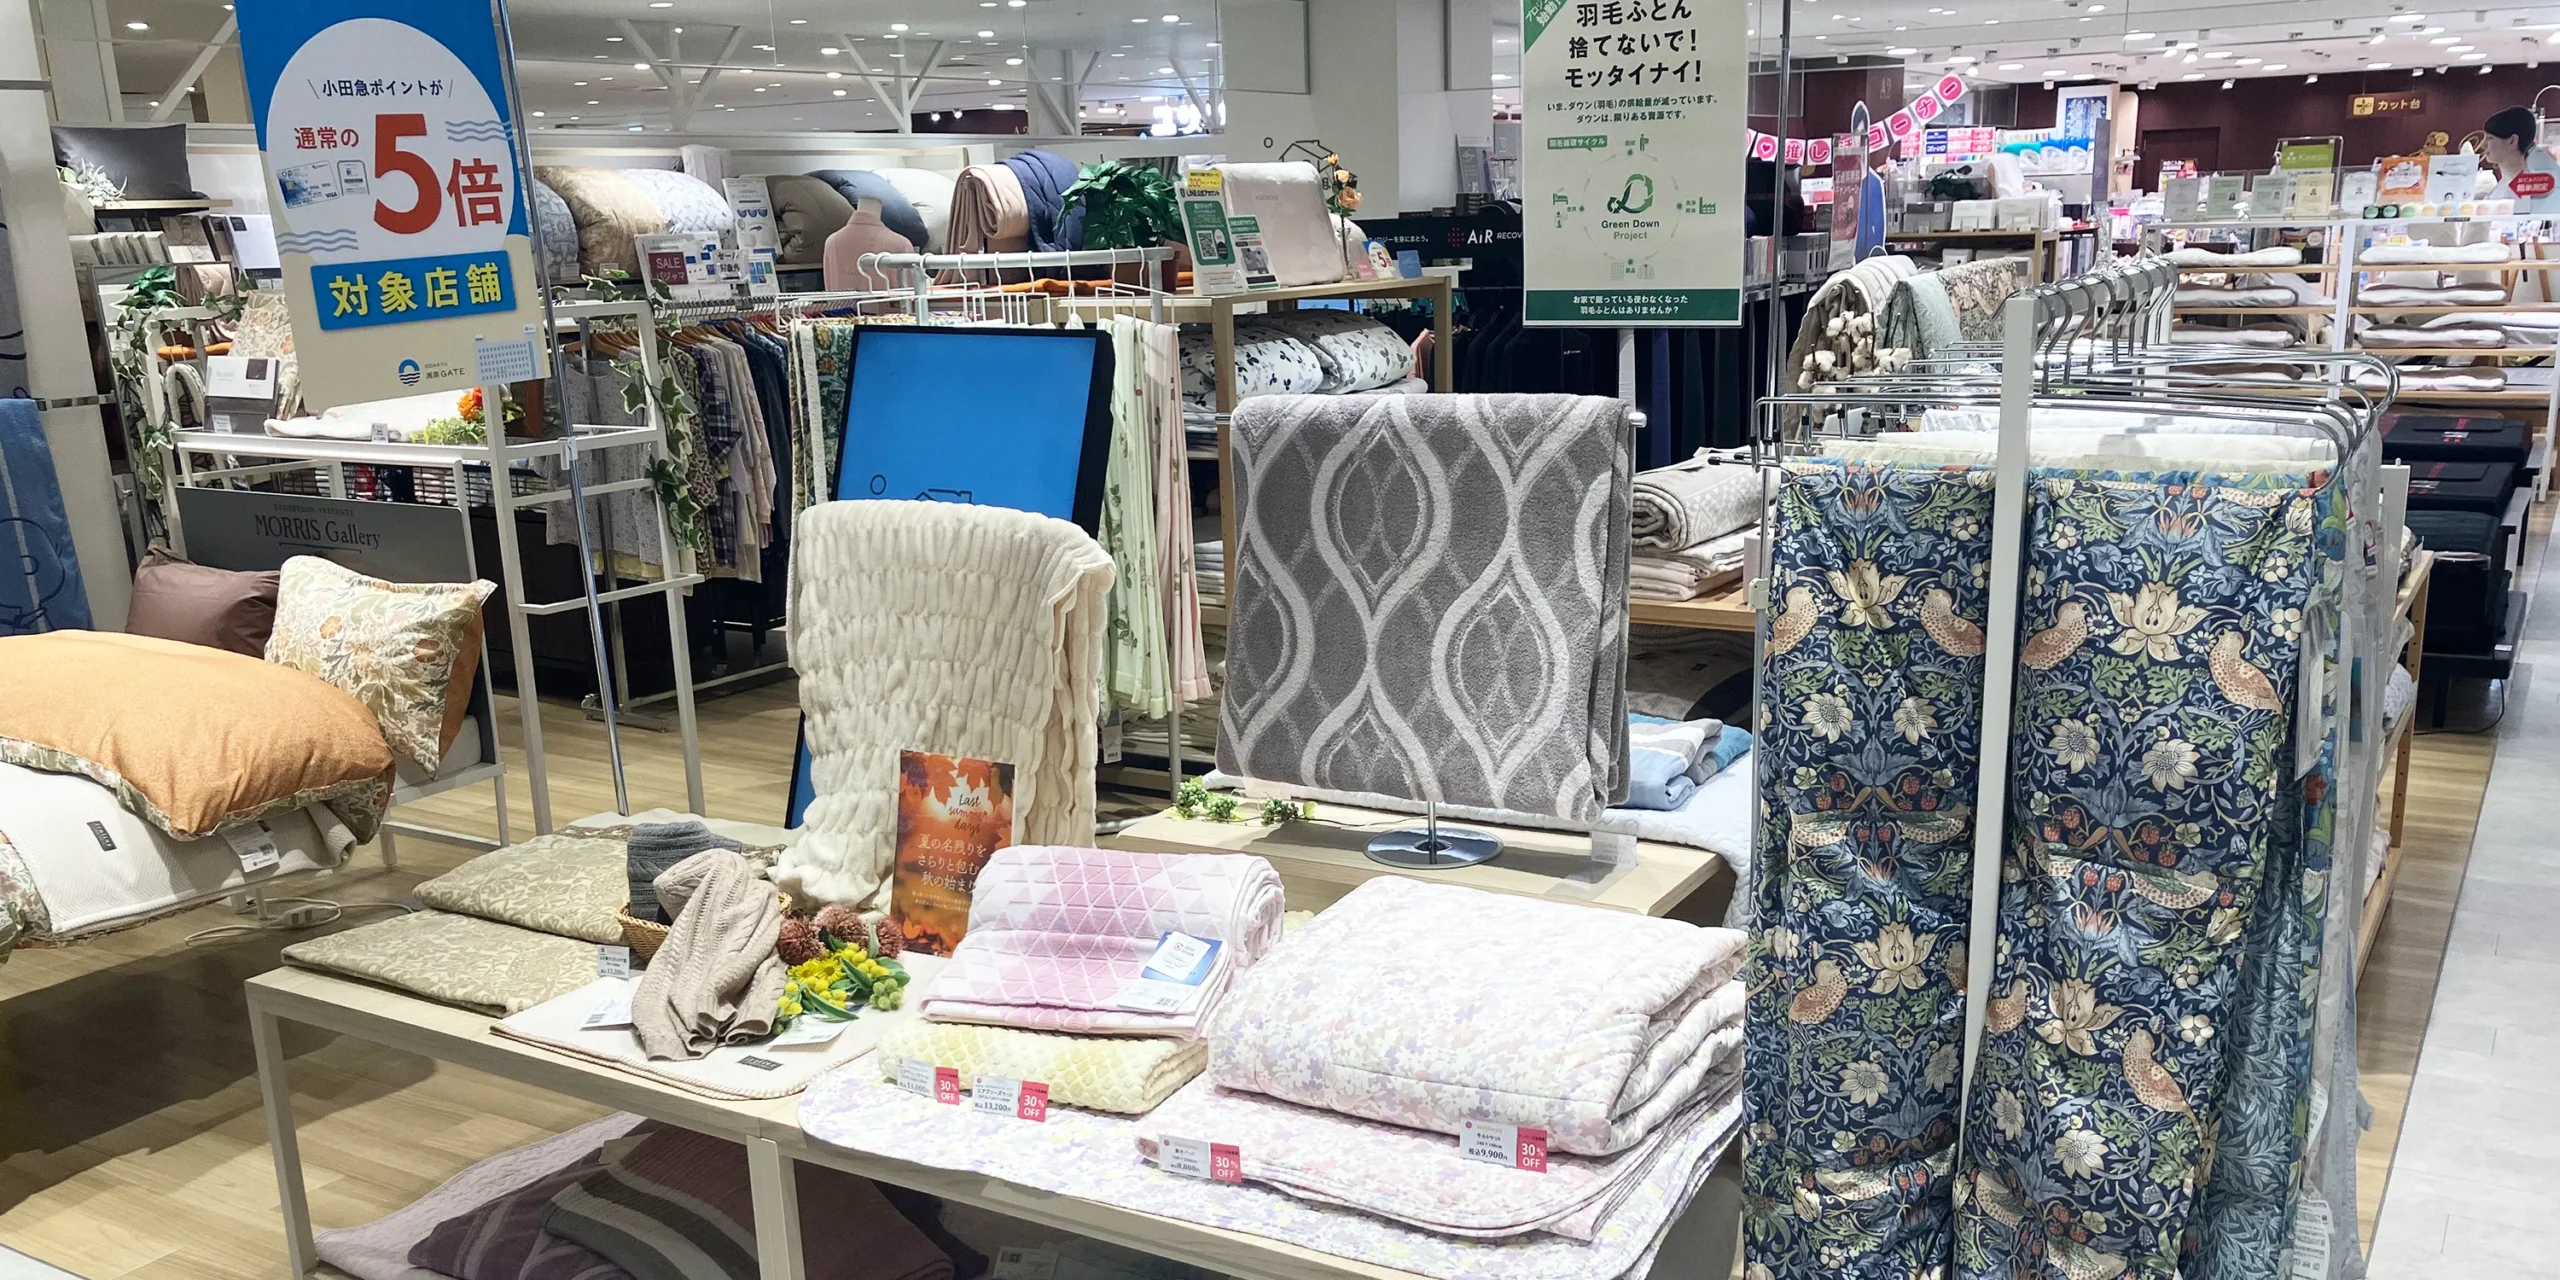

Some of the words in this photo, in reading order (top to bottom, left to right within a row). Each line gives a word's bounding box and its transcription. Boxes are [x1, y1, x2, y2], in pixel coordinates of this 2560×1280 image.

[1576, 0, 1692, 28] 羽毛ふとん
[1569, 29, 1697, 59] 捨てないで!
[1565, 60, 1702, 88] モッタイナイ!
[322, 78, 444, 97] 小田急ポイントが
[2377, 98, 2421, 111] カット台
[1576, 110, 1687, 124] ダウンは、限りある資源です。
[294, 126, 360, 150] 通常の
[1601, 220, 1630, 229] Green
[1633, 219, 1660, 228] Down
[1613, 231, 1648, 241] Project
[656, 257, 681, 269] SALE
[328, 262, 502, 318] 対象店舗
[1573, 295, 1688, 304] お家で眠っている使わなくなった
[425, 368, 465, 379] 湘南GATE
[254, 514, 321, 541] MORRIS
[325, 520, 380, 550] Gallery
[958, 794, 981, 807] Last
[948, 806, 991, 820] summer
[954, 818, 982, 837] days
[918, 833, 987, 858] 夏の名残りを
[918, 854, 980, 876] さらりと包む
[940, 1080, 958, 1092] 30%
[940, 1092, 955, 1101] OFF
[1024, 1095, 1045, 1108] 30%
[1023, 1107, 1041, 1117] OFF
[1521, 1143, 1545, 1157] 30%
[1215, 1156, 1239, 1169] 30%
[1522, 1158, 1540, 1168] OFF
[1217, 1168, 1235, 1179] OFF
